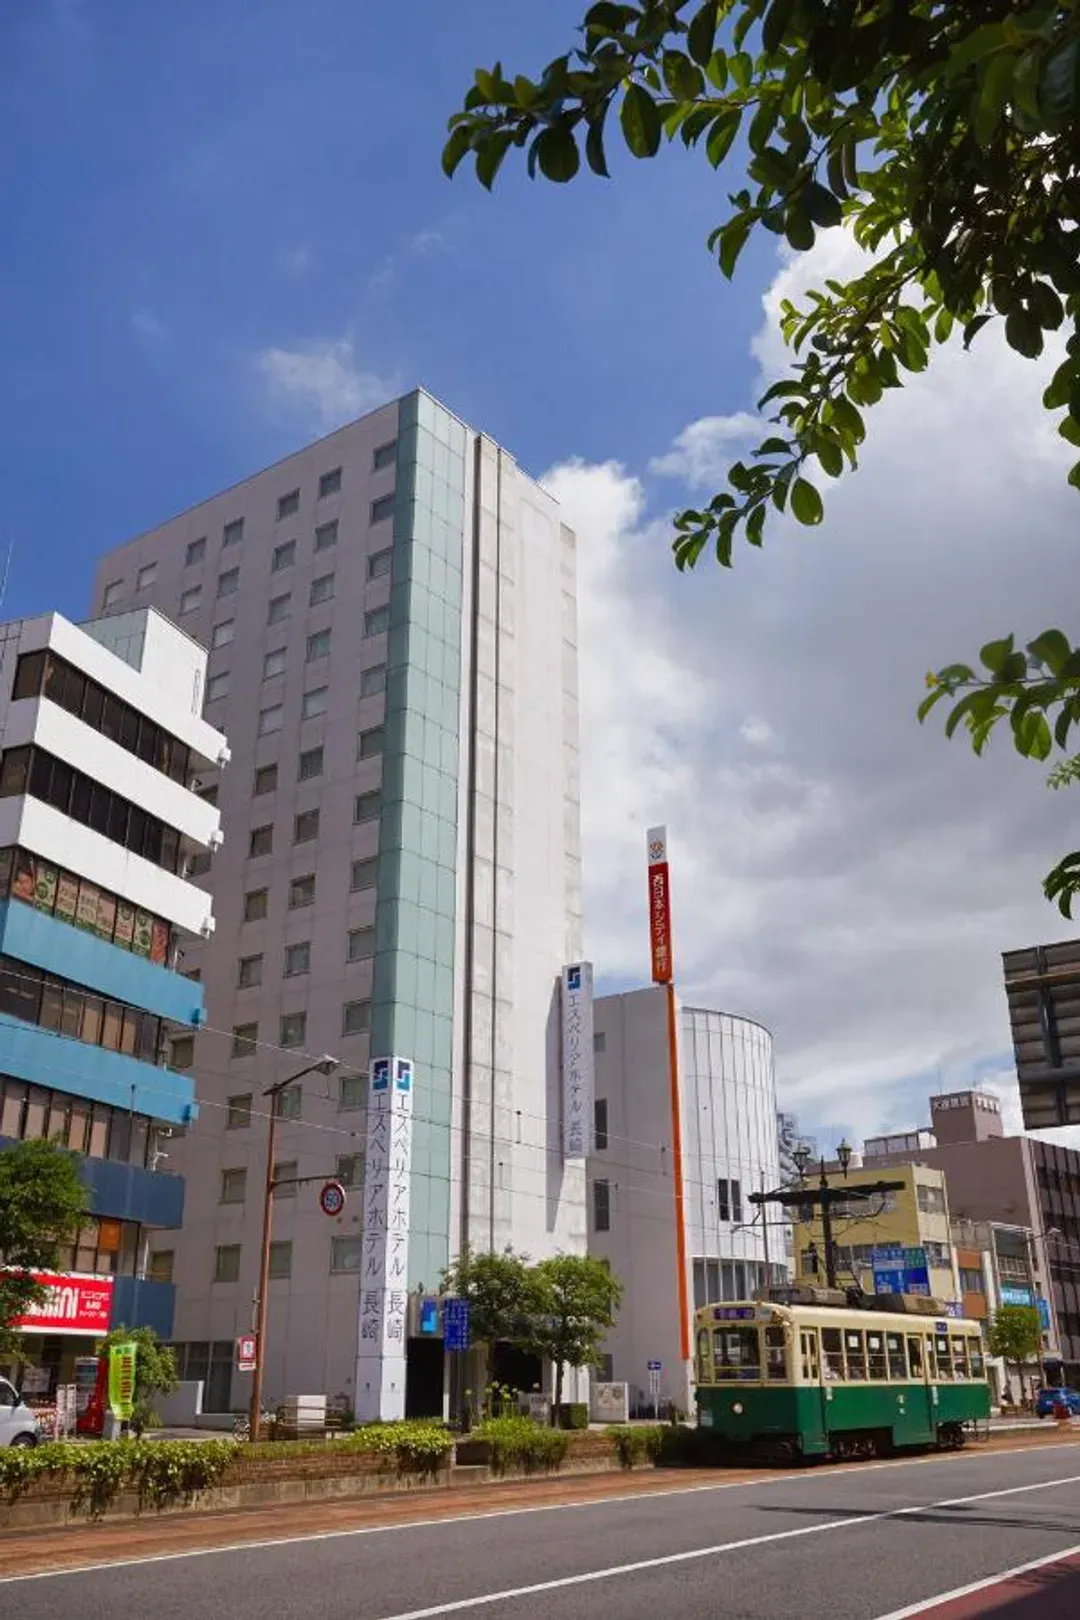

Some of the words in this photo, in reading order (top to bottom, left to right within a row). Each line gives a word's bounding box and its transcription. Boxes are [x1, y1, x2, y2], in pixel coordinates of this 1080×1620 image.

[365, 1095, 388, 1276] エスペリアホテル
[389, 1095, 410, 1276] エスペリアホテル
[361, 1292, 380, 1343] 長崎
[387, 1291, 405, 1344] 長崎
